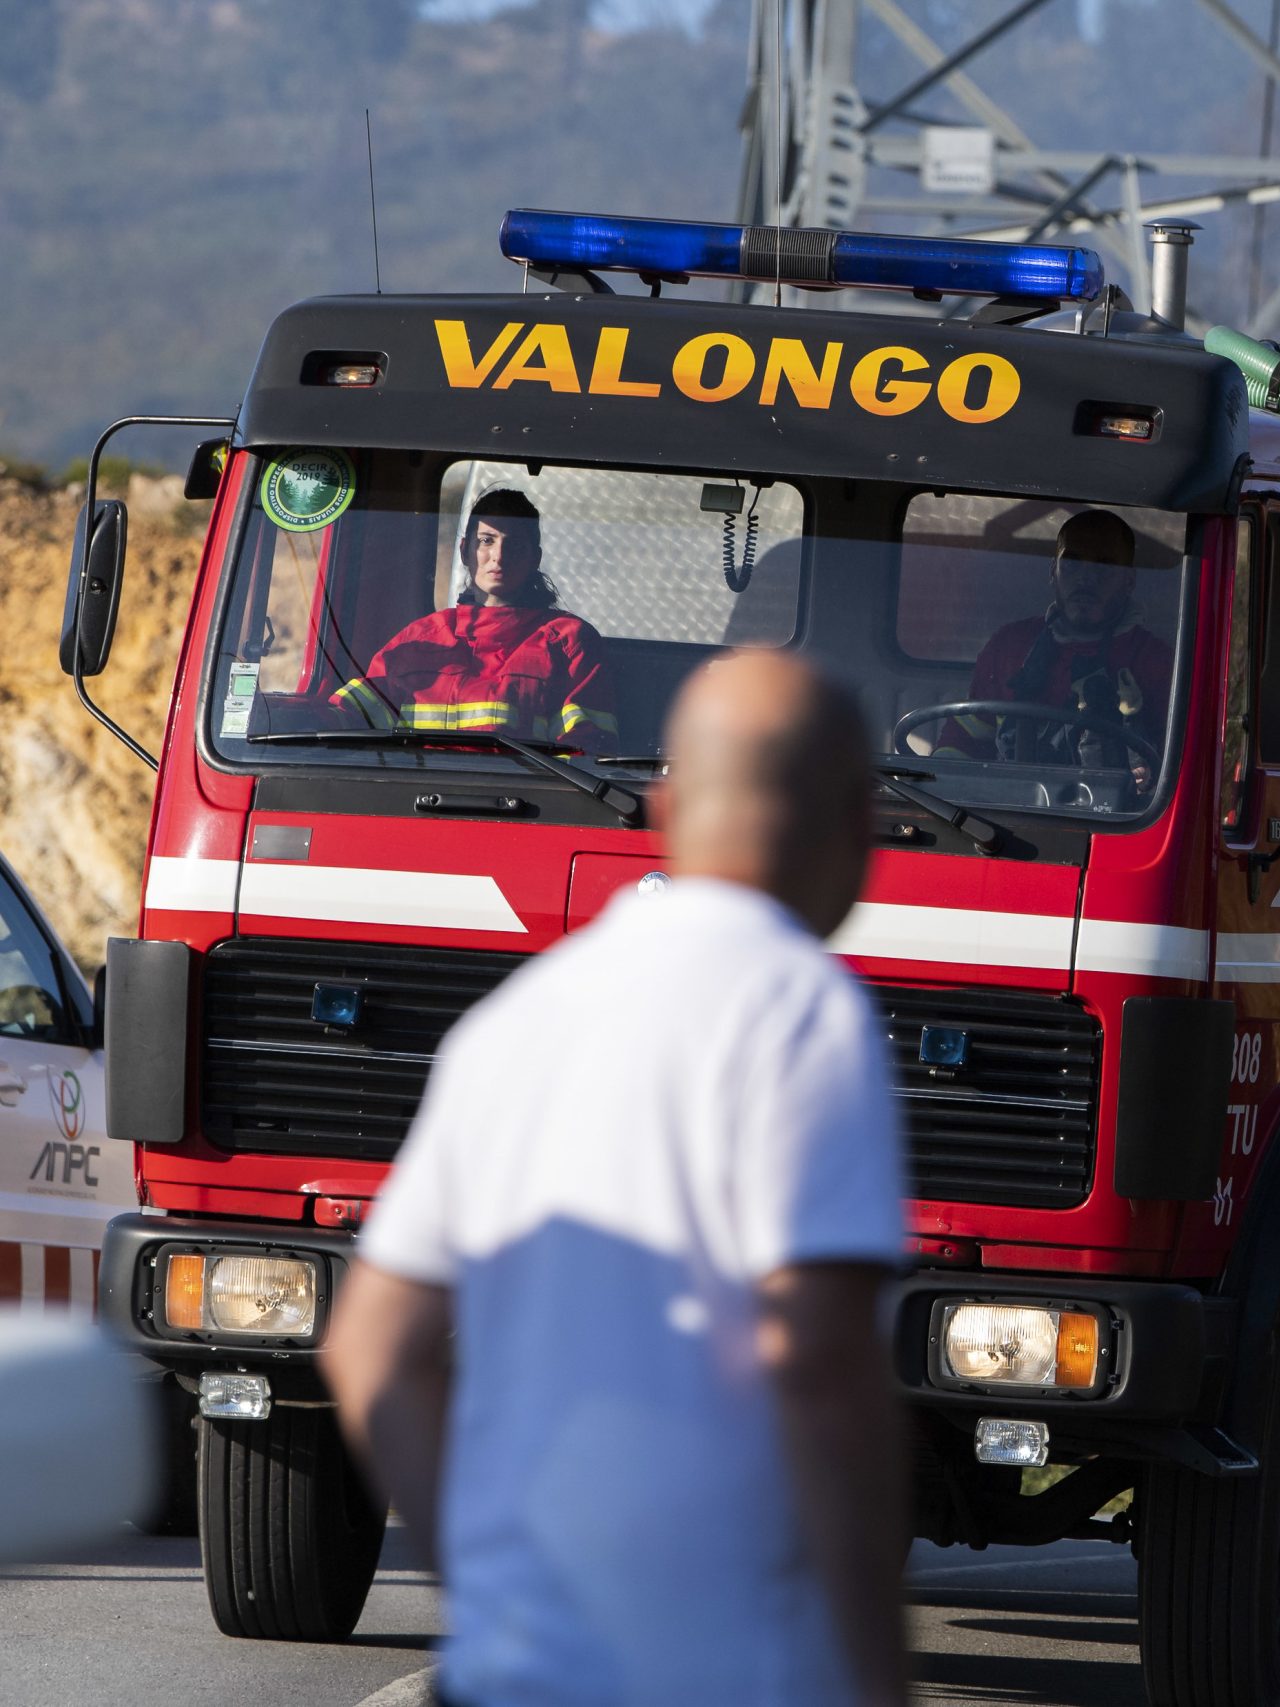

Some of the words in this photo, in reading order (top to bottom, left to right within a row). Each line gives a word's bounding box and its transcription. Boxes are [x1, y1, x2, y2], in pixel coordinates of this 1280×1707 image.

[434, 319, 1021, 424] VALONGO
[292, 463, 327, 472] DECIR
[296, 472, 321, 481] 2019
